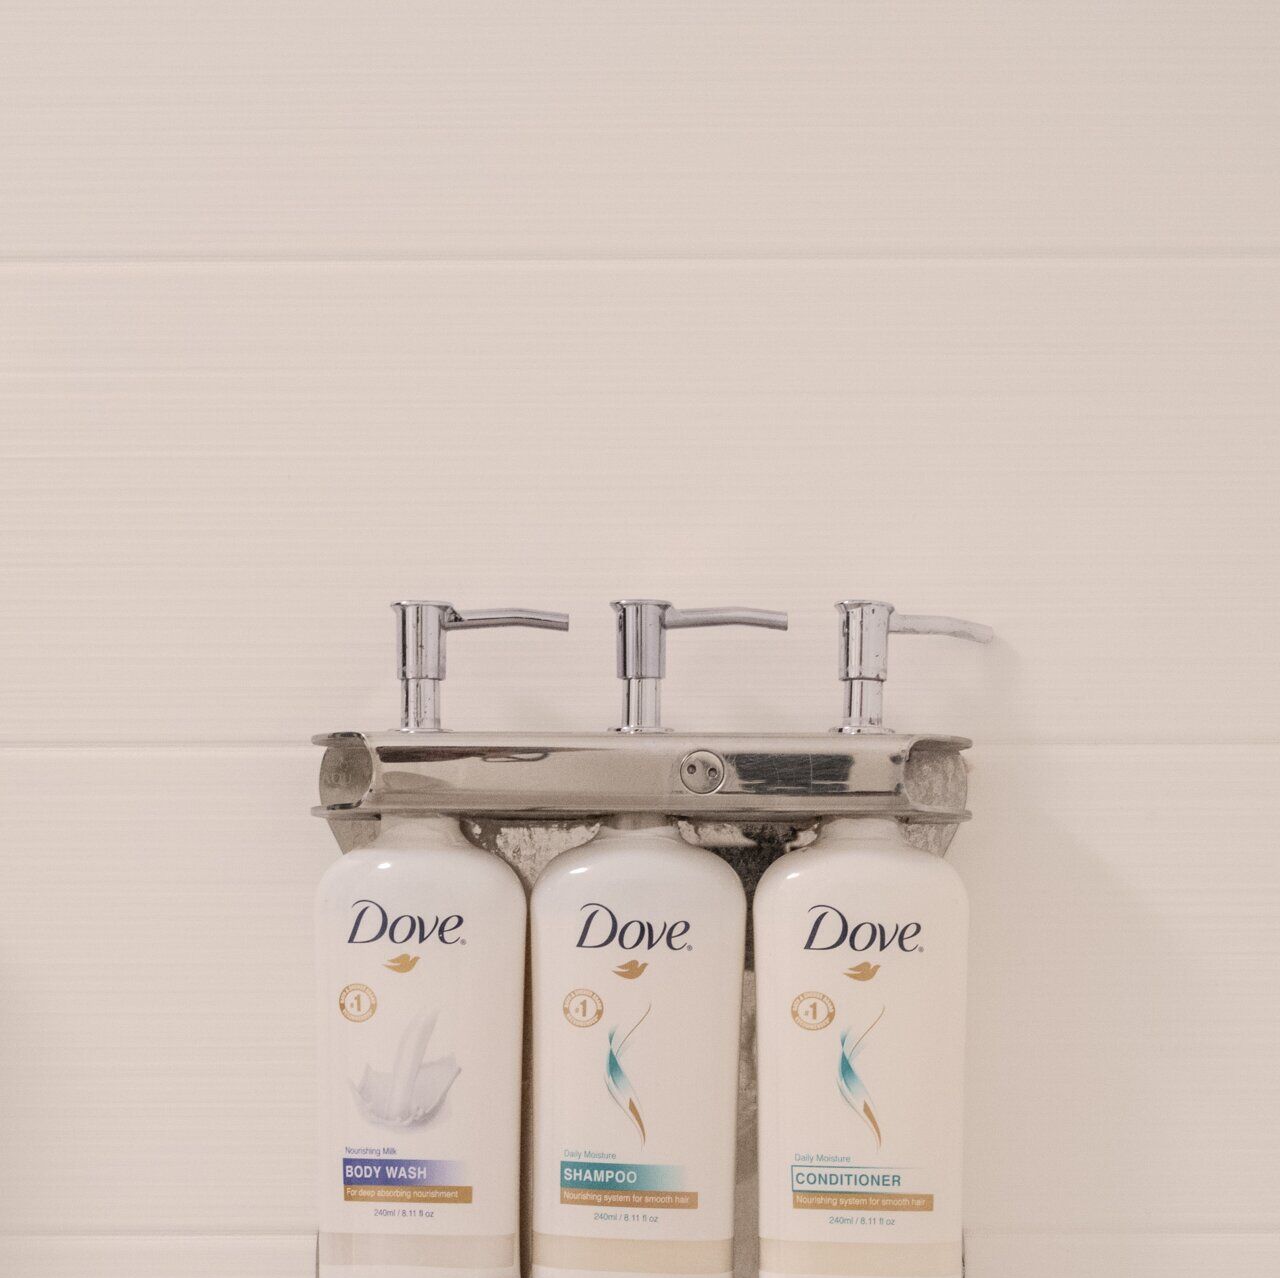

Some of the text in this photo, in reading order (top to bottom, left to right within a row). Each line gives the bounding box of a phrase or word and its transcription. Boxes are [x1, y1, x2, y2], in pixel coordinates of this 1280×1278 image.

[345, 1146, 397, 1157] Nourishing Milk
[564, 1149, 616, 1160] Daily Moisture
[794, 1153, 851, 1164] Daily Moisture
[345, 1165, 427, 1179] BODY WASH
[563, 1168, 637, 1183] SHAMPOO
[795, 1172, 901, 1187] CONDITIONER
[346, 1187, 458, 1199] For deep absorbing nourishment
[563, 1191, 689, 1204] Nourishing system for smooth hair
[796, 1195, 926, 1207] Nourishing system for smooth hair
[374, 1209, 396, 1217] 240ml
[401, 1209, 417, 1217] 8.11
[425, 1210, 435, 1218] oz
[594, 1212, 618, 1221] 240ml
[648, 1214, 659, 1222] oz
[828, 1216, 853, 1225] 240ml
[860, 1217, 876, 1225] 8.11
[885, 1218, 895, 1226] oz
